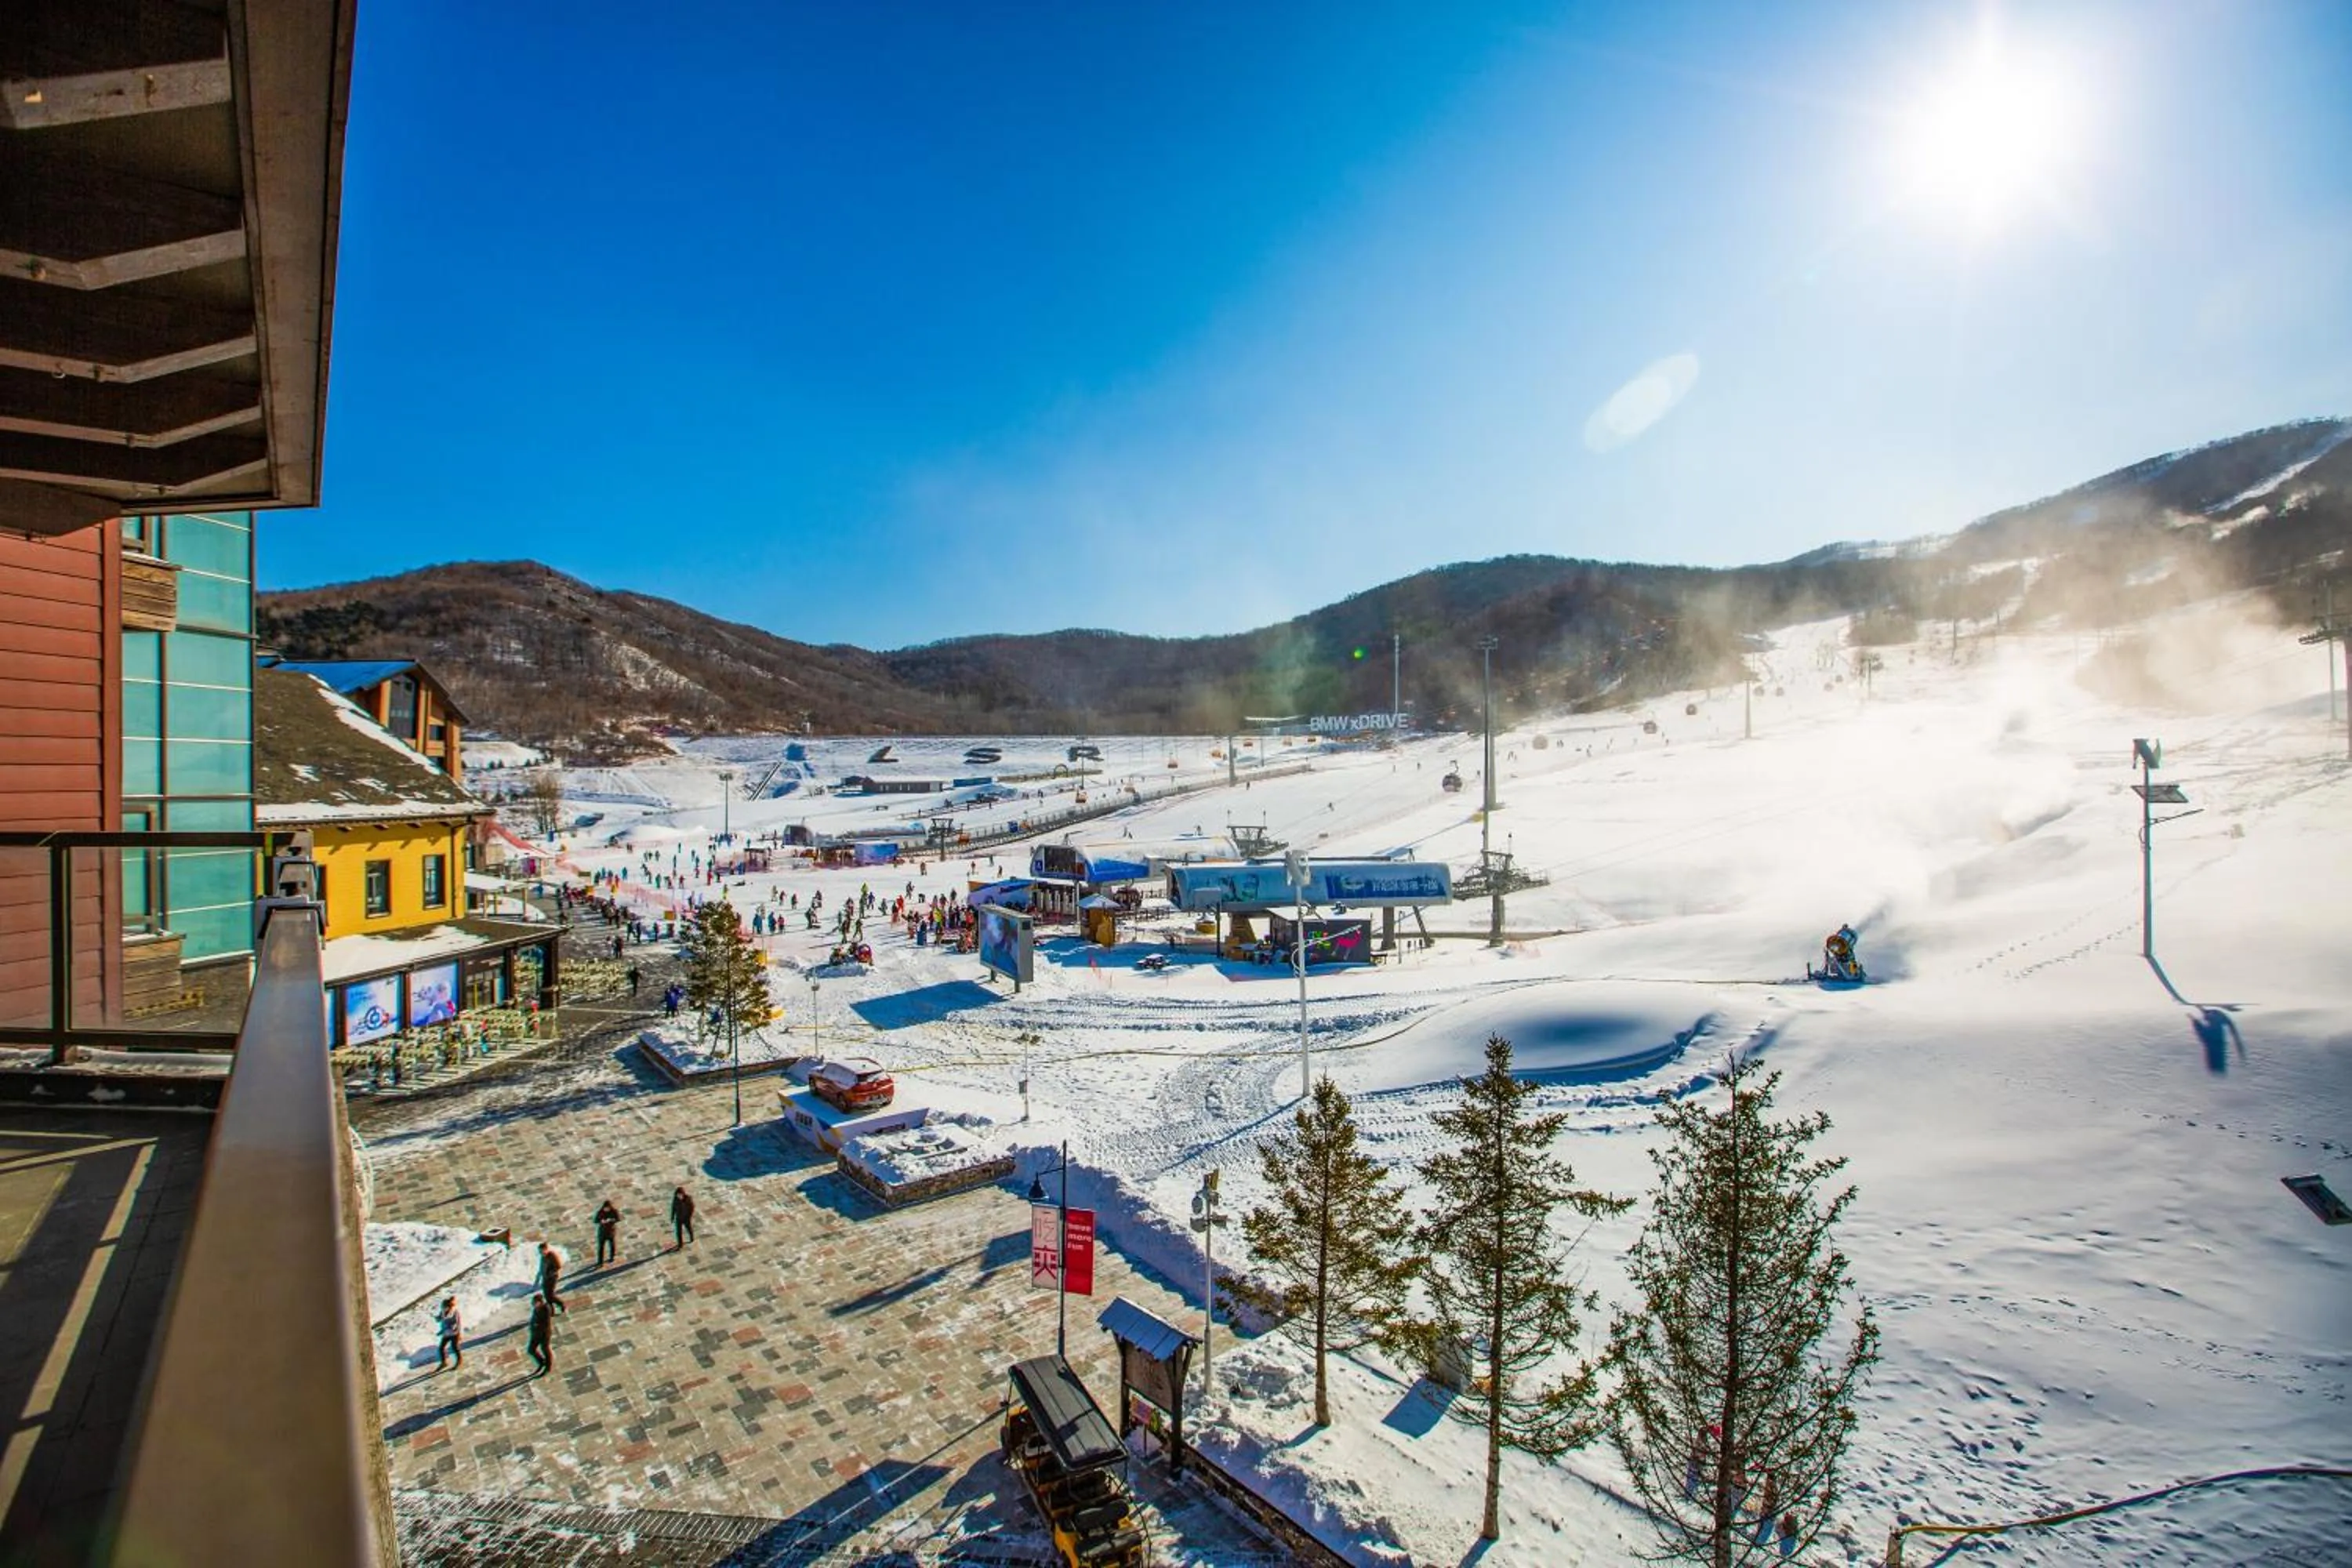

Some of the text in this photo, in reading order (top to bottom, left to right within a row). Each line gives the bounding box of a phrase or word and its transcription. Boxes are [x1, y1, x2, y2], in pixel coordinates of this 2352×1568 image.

[1310, 713, 1409, 731] BMW xDRIVE
[1067, 1233, 1092, 1243] more
